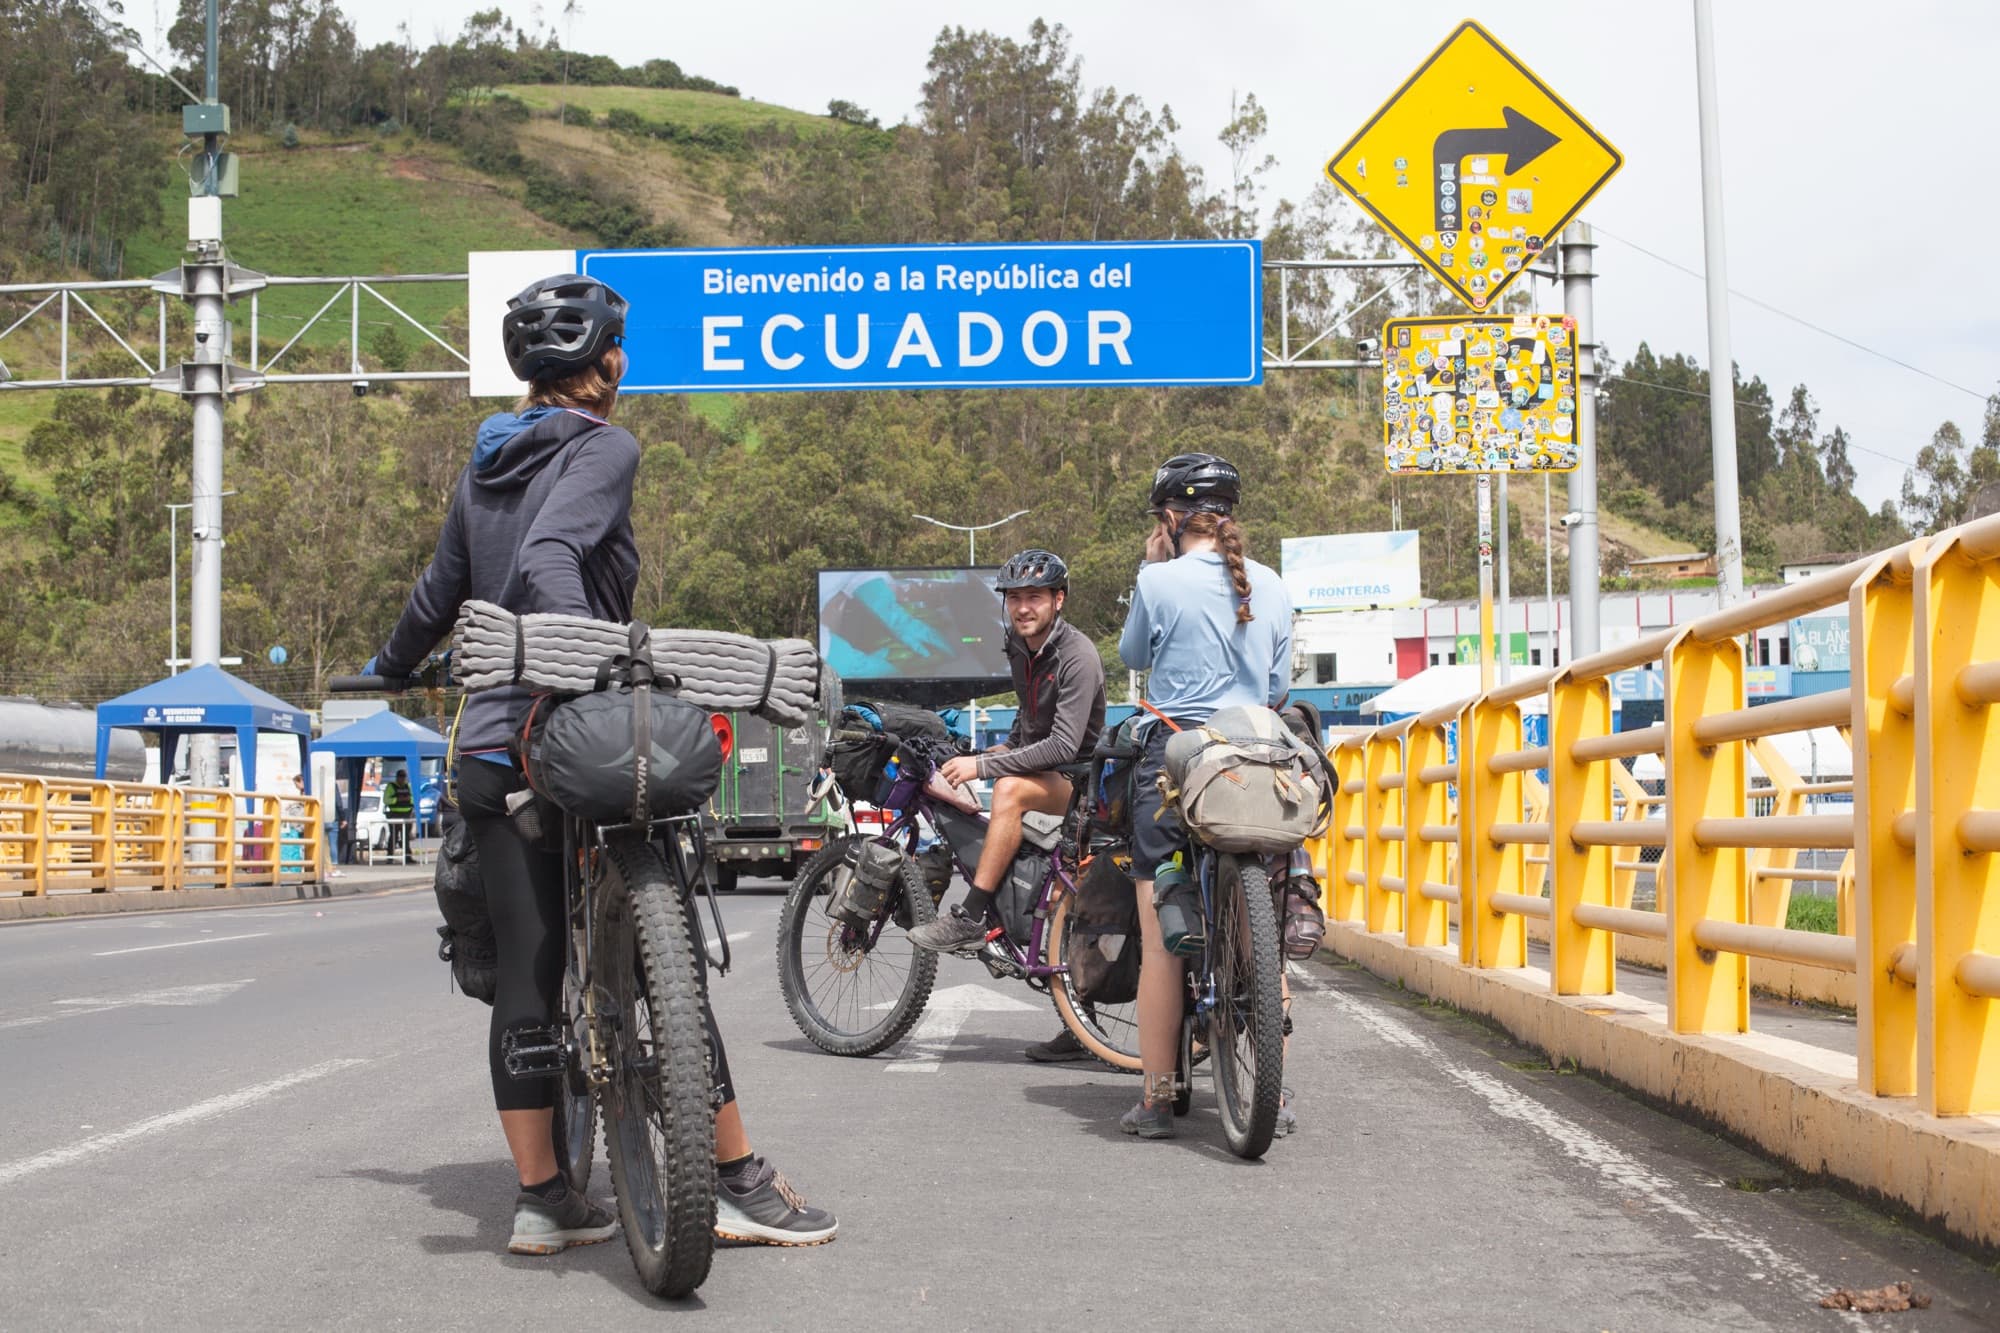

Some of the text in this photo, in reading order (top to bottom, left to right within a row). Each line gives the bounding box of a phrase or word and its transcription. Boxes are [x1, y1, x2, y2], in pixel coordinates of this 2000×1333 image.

[703, 262, 1132, 296] Bienvenido a la República del
[702, 309, 1133, 371] ECUADOR
[1308, 584, 1391, 598] FRONTERAS
